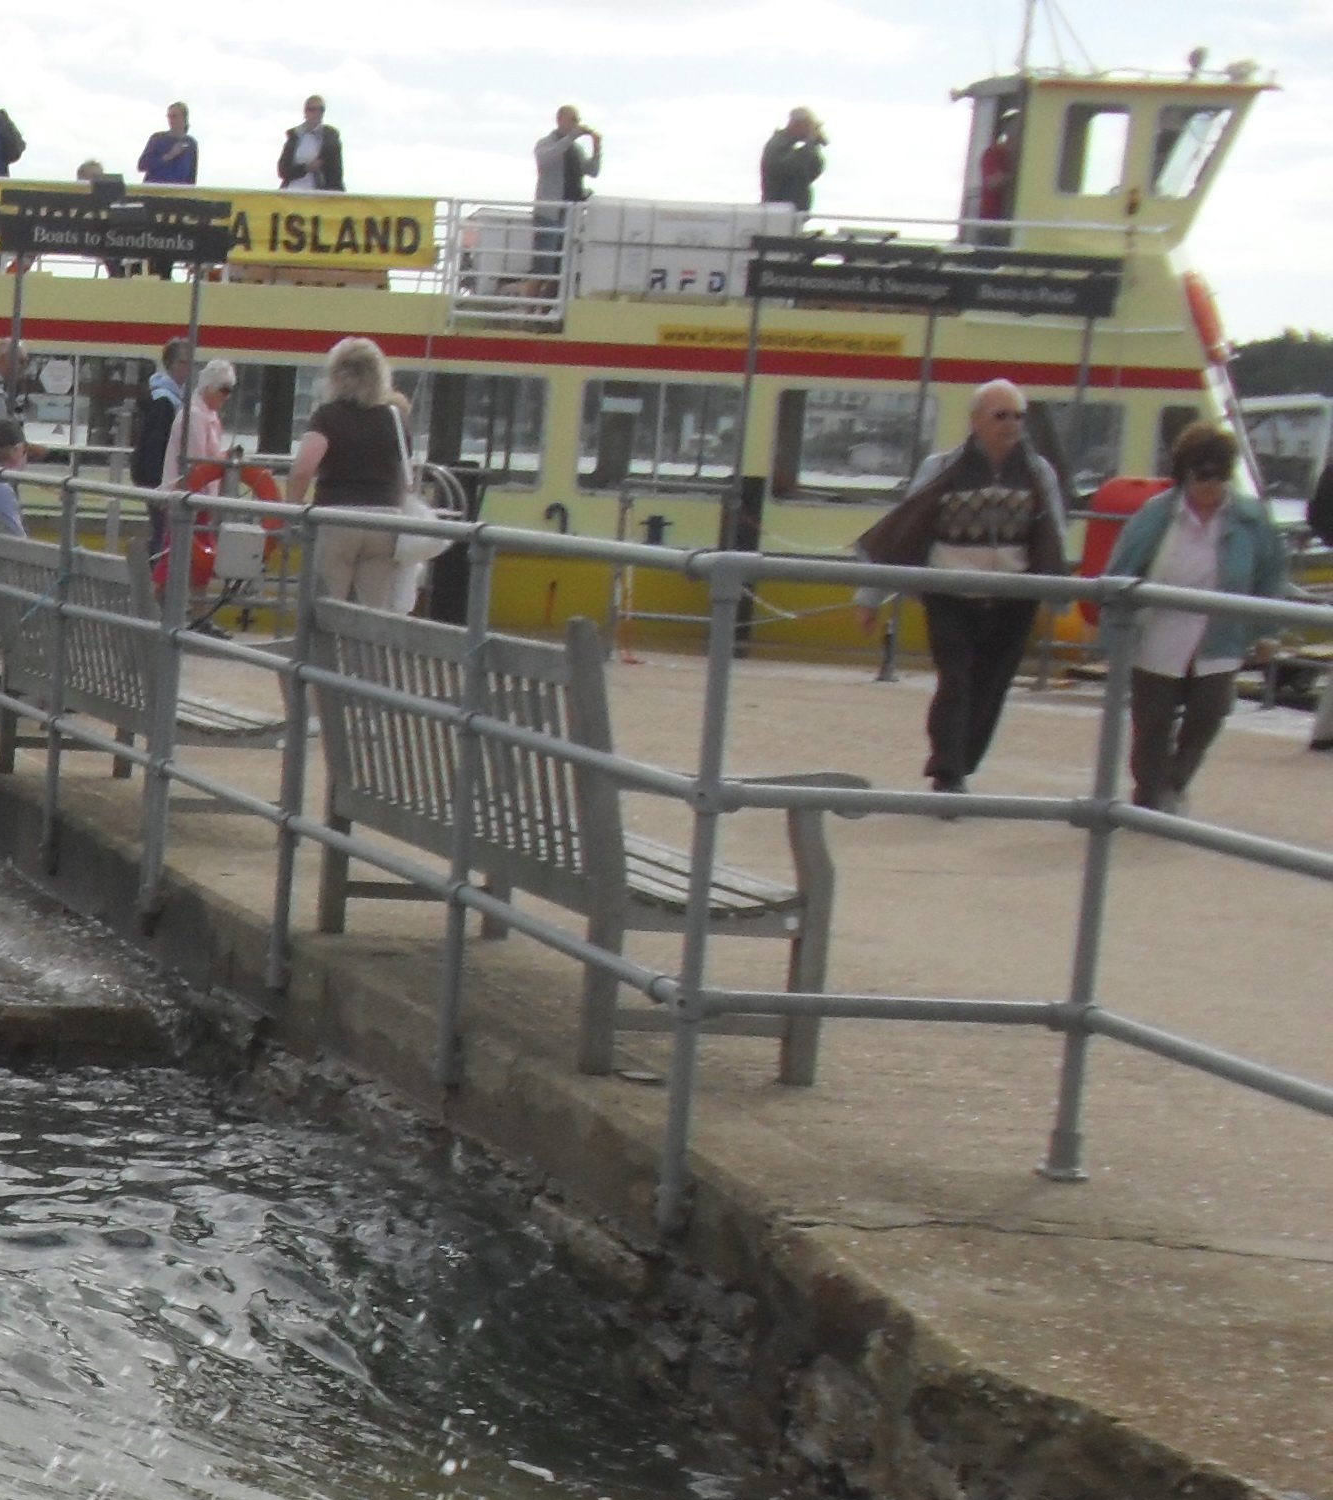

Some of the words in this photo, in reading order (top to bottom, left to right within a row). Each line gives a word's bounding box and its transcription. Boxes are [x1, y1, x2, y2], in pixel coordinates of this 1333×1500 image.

[34, 226, 78, 245] Boats
[85, 230, 100, 246] to
[105, 229, 194, 252] Sandbanks
[269, 211, 421, 256] ISLAND
